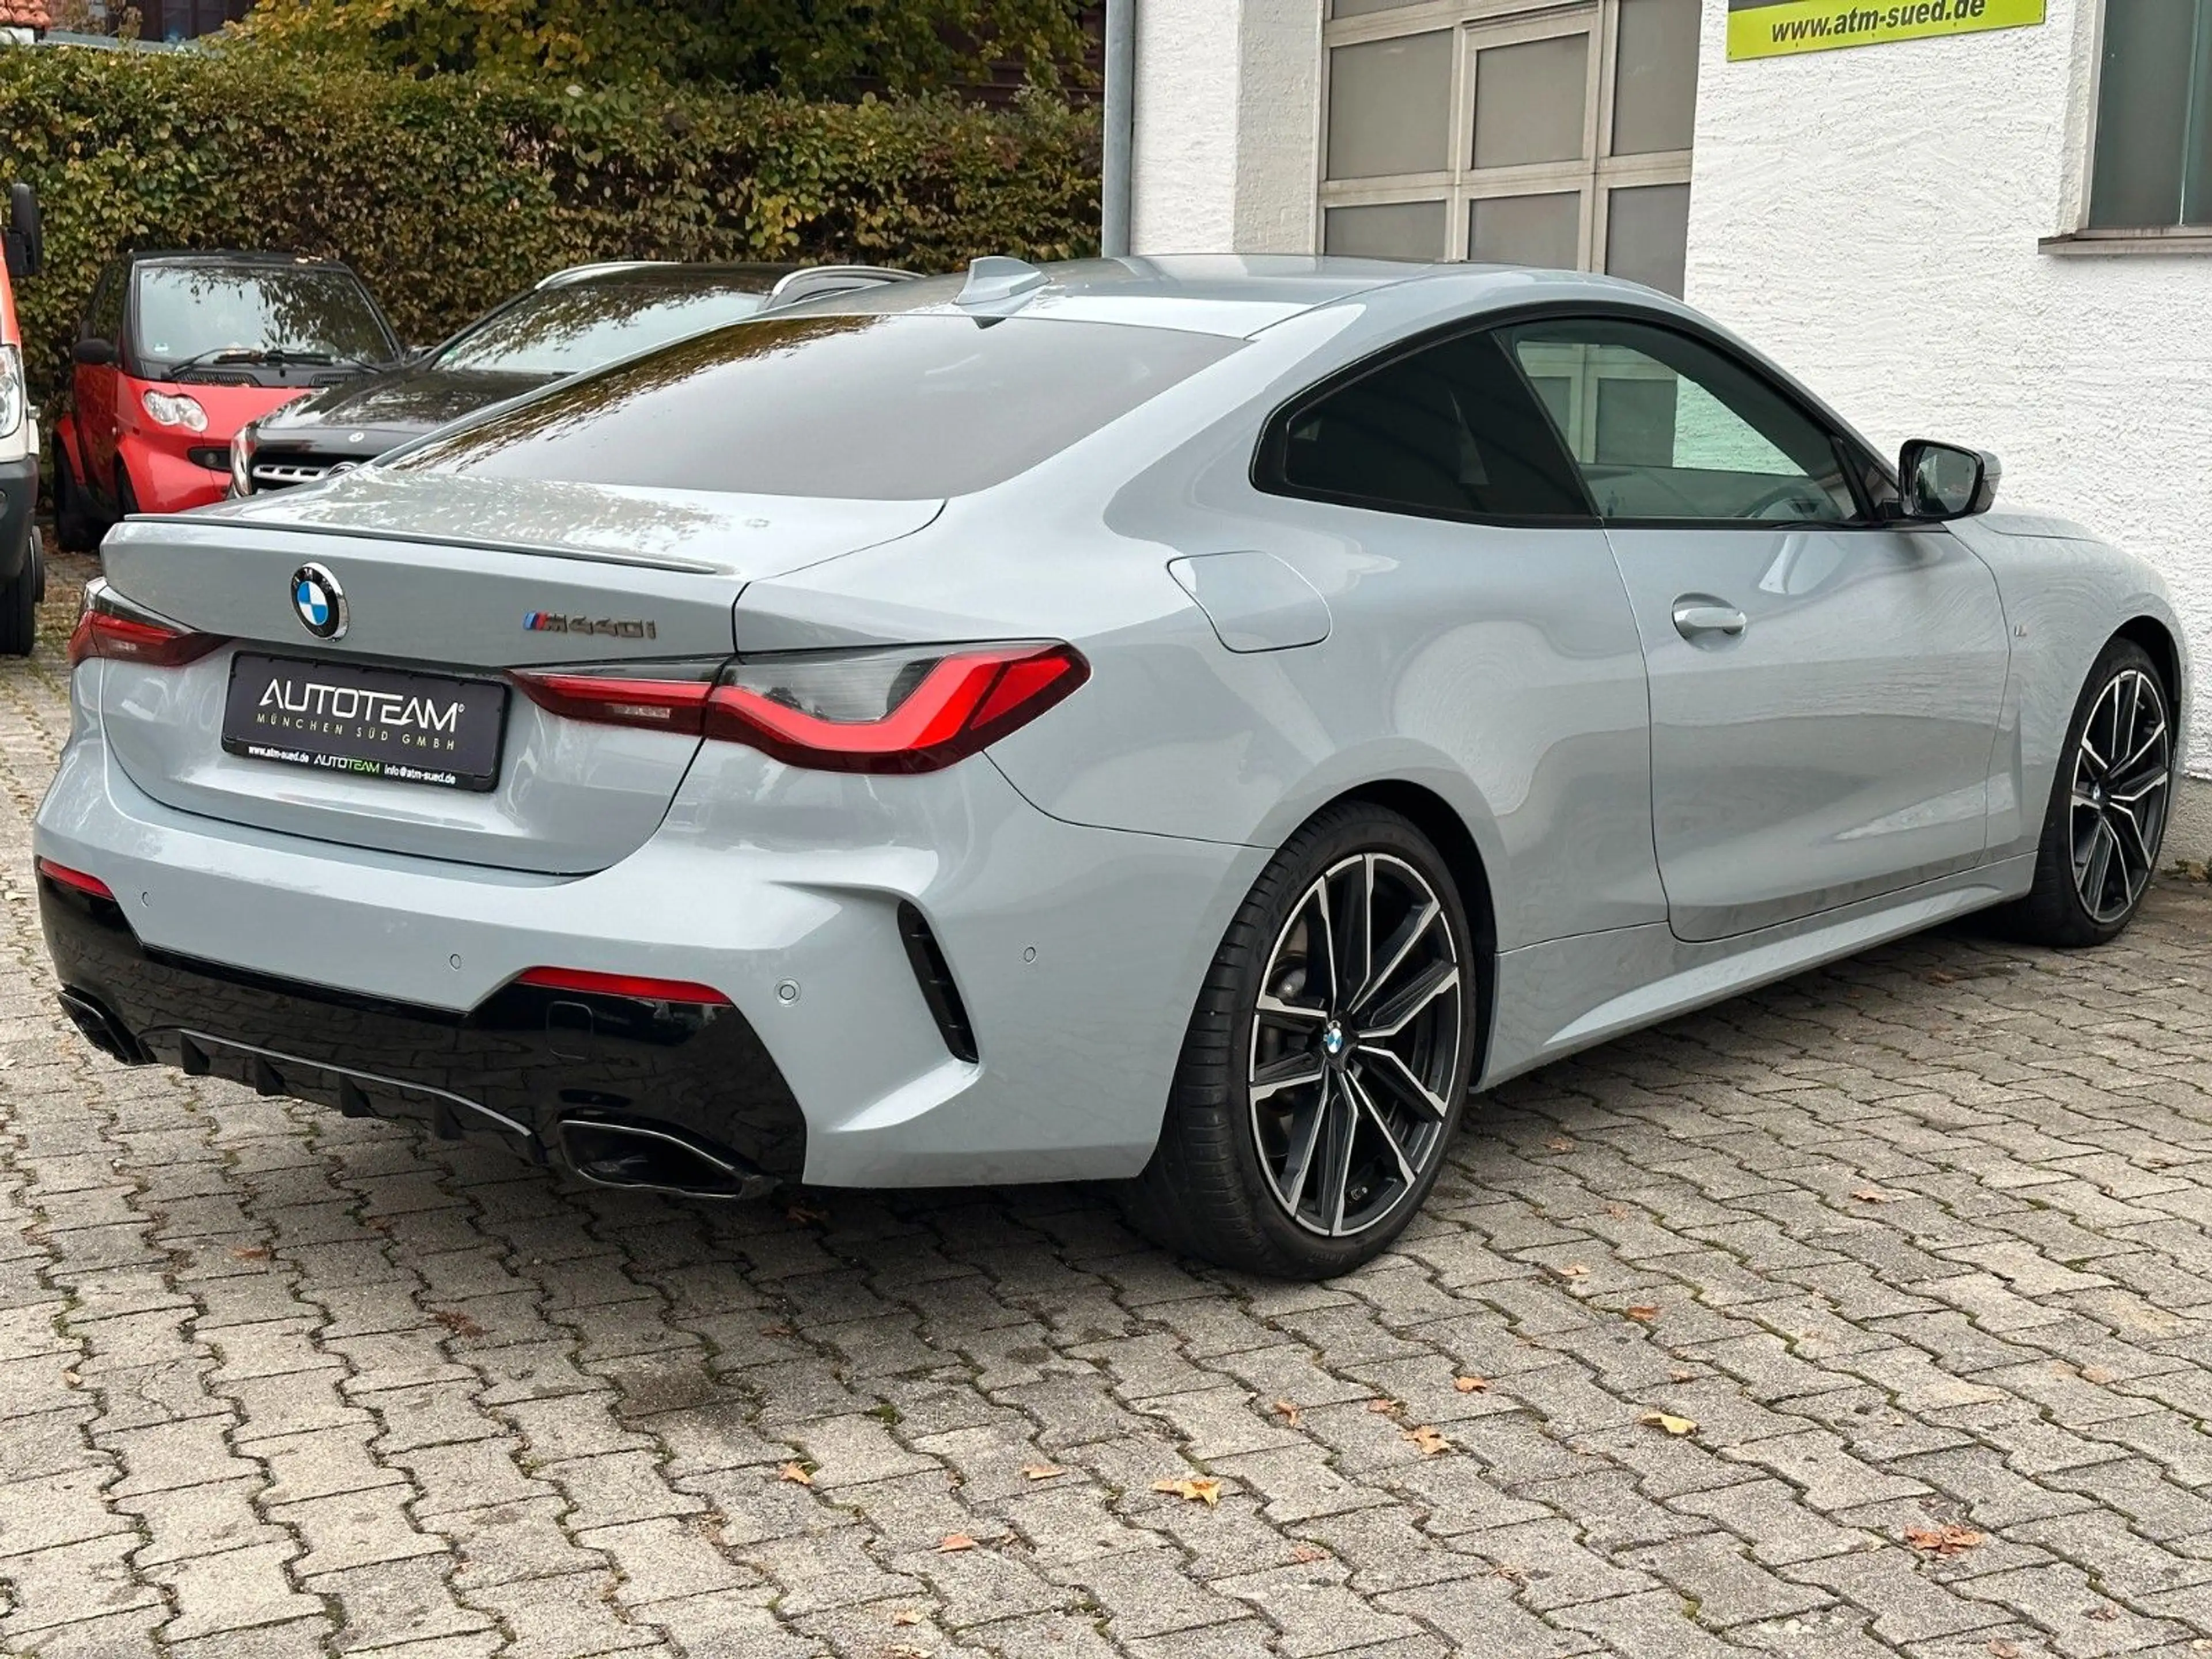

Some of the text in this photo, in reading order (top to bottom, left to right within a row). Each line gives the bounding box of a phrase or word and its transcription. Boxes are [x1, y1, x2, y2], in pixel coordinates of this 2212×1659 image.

[1772, 0, 1984, 42] www.atm-sued.de
[257, 713, 454, 750] MÜNCHEN SÜD GMBH
[248, 746, 456, 785] www.atm-sued.de AUTOTEAM info@atm-sued.de
